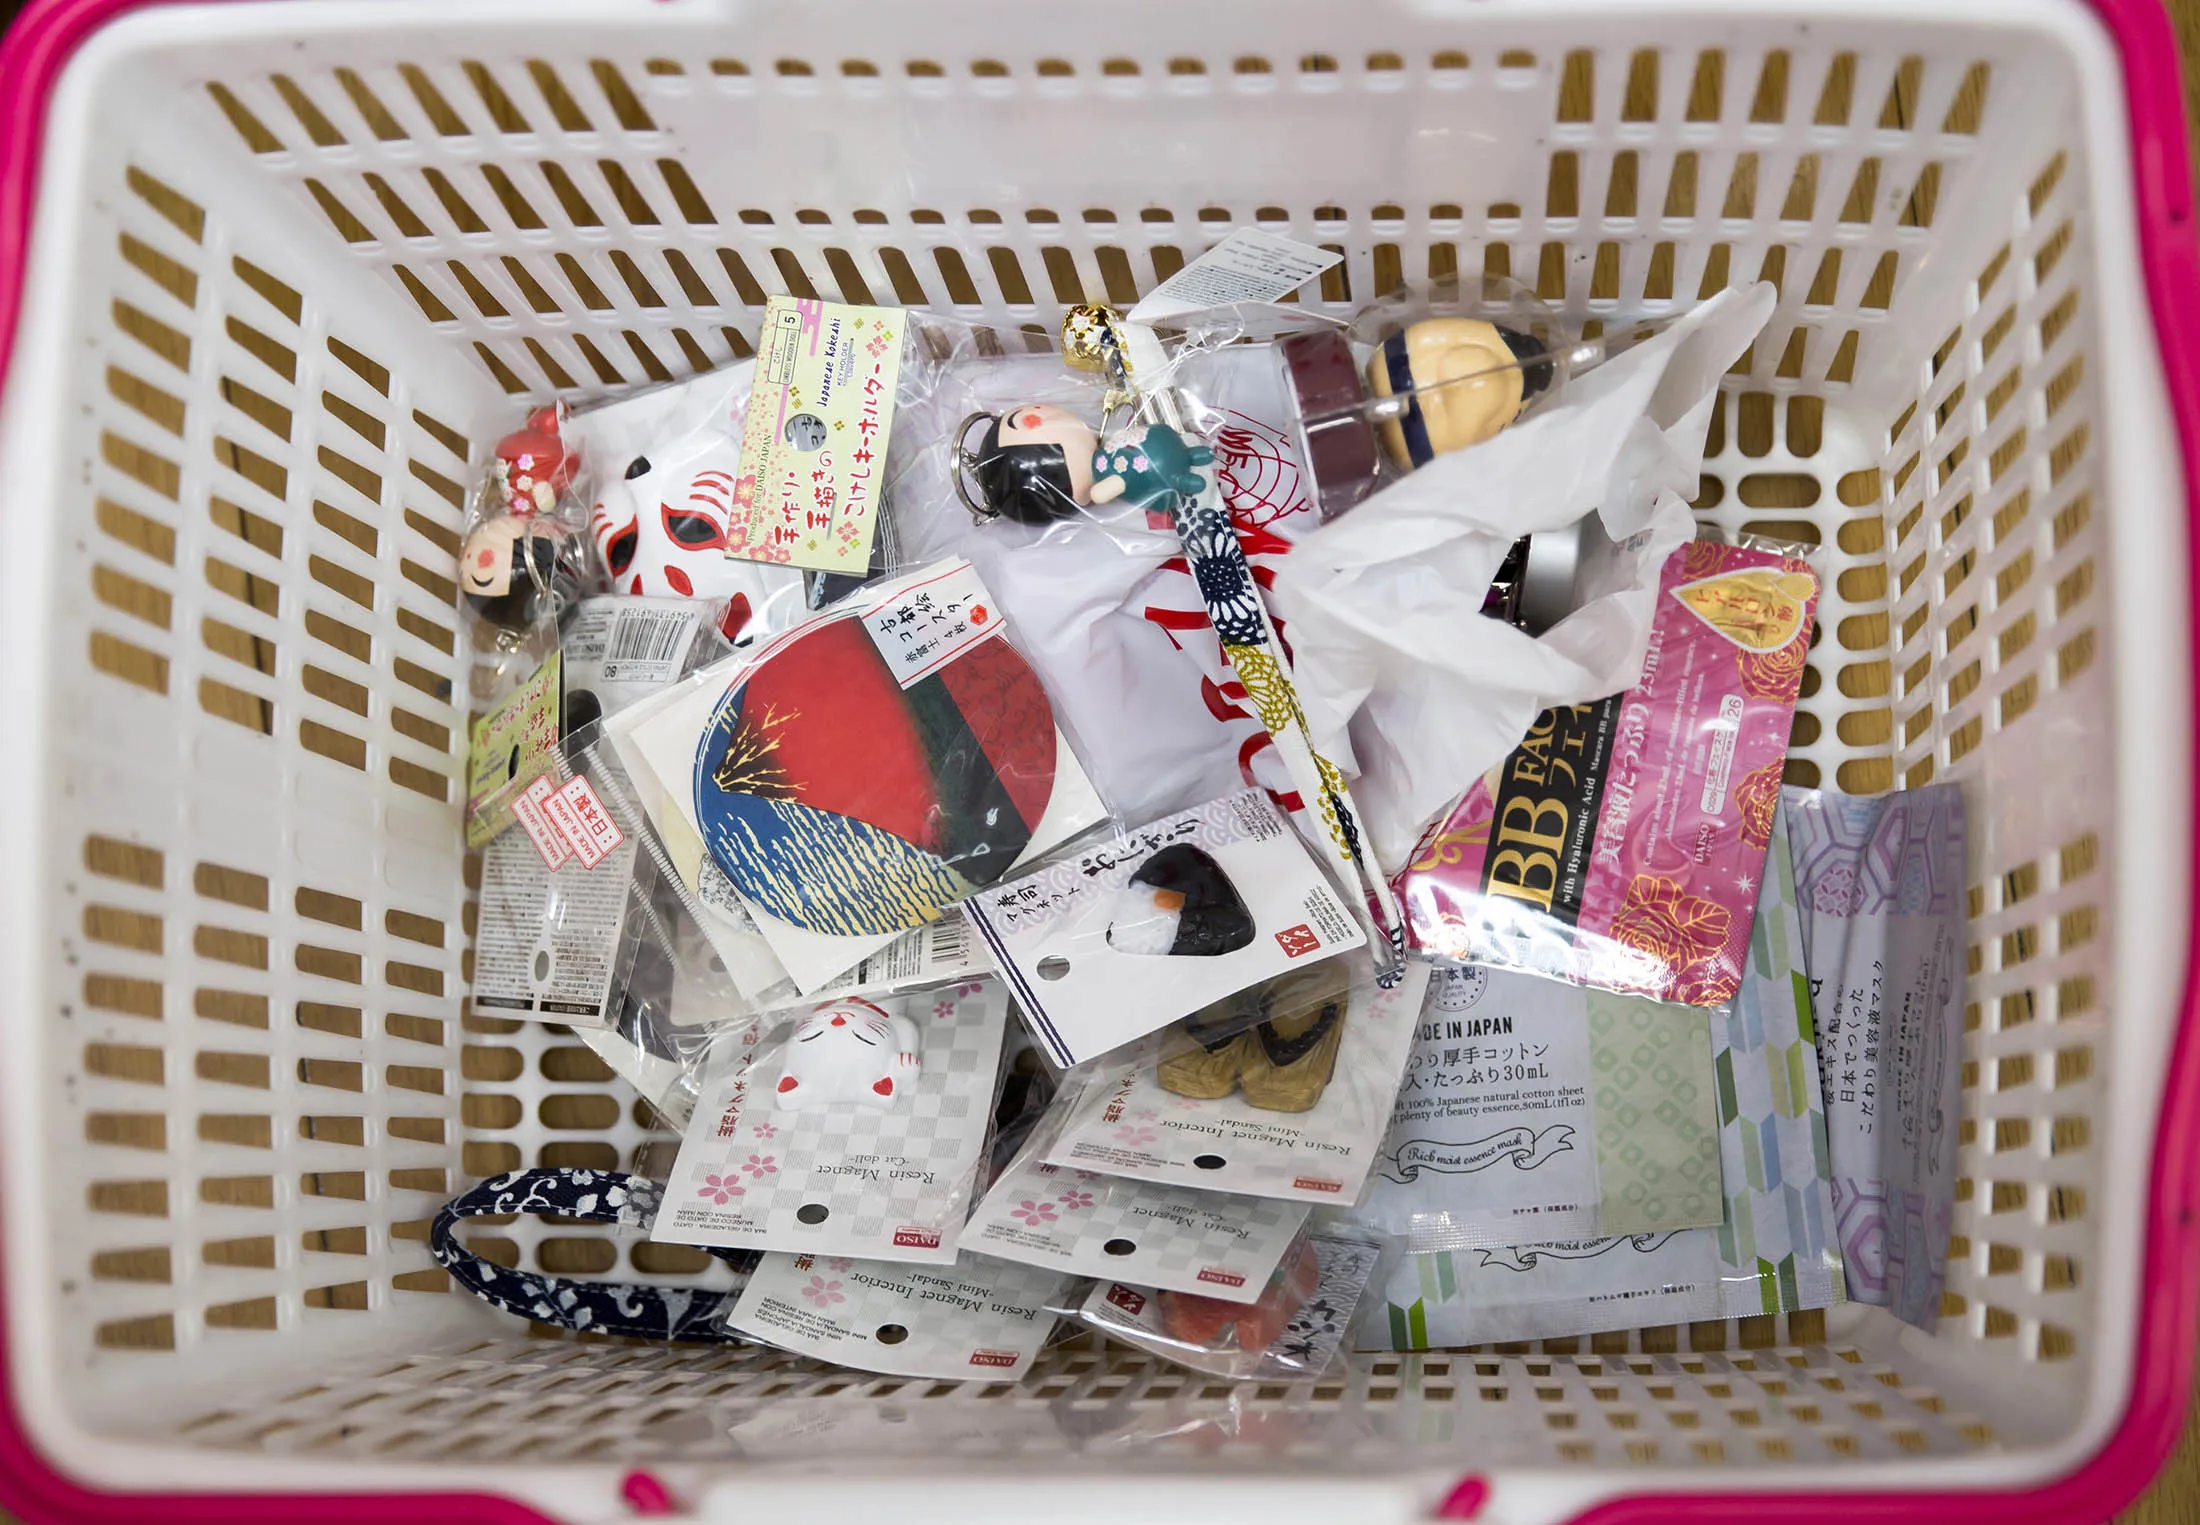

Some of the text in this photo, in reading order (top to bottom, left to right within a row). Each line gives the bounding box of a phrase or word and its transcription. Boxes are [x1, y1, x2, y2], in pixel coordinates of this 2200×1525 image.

[784, 315, 795, 323] 5
[816, 316, 841, 407] Japanese Kokeshi
[836, 341, 849, 386] KEY HOLDER
[760, 434, 771, 462] JAPAN
[843, 362, 888, 518] こけしキーホルダー
[754, 462, 767, 491] DAISO
[804, 448, 841, 532] 手描きの
[746, 505, 760, 541] Produced
[881, 593, 935, 634] 古都絵
[900, 594, 973, 642] コースター
[605, 666, 617, 678] 80
[1727, 698, 1741, 717] 26
[1548, 702, 1593, 788] フェイ
[1582, 777, 1596, 807] Acid
[1600, 704, 1651, 863] 美容液たっぷり
[520, 800, 538, 827] JAPAN
[574, 793, 608, 836] 日本製
[1487, 705, 1570, 911] BB FAC
[552, 799, 594, 859] MADE IN JAPAN
[1694, 823, 1710, 862] DAISO
[544, 838, 560, 862] MADE
[1082, 819, 1200, 877] おにぎり
[1567, 811, 1588, 880] Hyaluronic
[998, 884, 1037, 909] 寿司
[1006, 887, 1081, 922] マグネット
[1563, 882, 1575, 903] with
[1417, 1016, 1513, 1041] DE IN JAPAN
[1841, 988, 1864, 1104] 日本でつくった
[1861, 961, 1884, 1133] こだわり美容液マスク
[1400, 1063, 1549, 1092] 入・たっぷり30mL
[718, 1053, 752, 1138] 樹脂マグネット
[1409, 1099, 1435, 1109] 100%
[1437, 1095, 1480, 1108] Japanese
[1483, 1091, 1519, 1102] natural
[1522, 1089, 1555, 1099] cotton
[1558, 1087, 1584, 1096] sheet
[1400, 1110, 1431, 1122] plenty
[1434, 1108, 1444, 1118] of
[1446, 1105, 1479, 1117] beauty
[1159, 1118, 1351, 1156] Resin Magnet Interior
[1407, 1147, 1435, 1162] Rich
[1463, 1146, 1496, 1165] essence
[1497, 1133, 1523, 1150] mask
[816, 1164, 935, 1185] Resin Magnet
[1132, 1207, 1250, 1239] Resin Magnet
[897, 1234, 938, 1247] DAISO
[760, 1302, 776, 1311] CON
[762, 1297, 797, 1311] INTERIOR
[850, 1272, 1039, 1321] Resin Magnet Interior
[777, 1308, 803, 1320] RESINA
[851, 1332, 867, 1340] MINI
[972, 1354, 1015, 1366] DAISO
